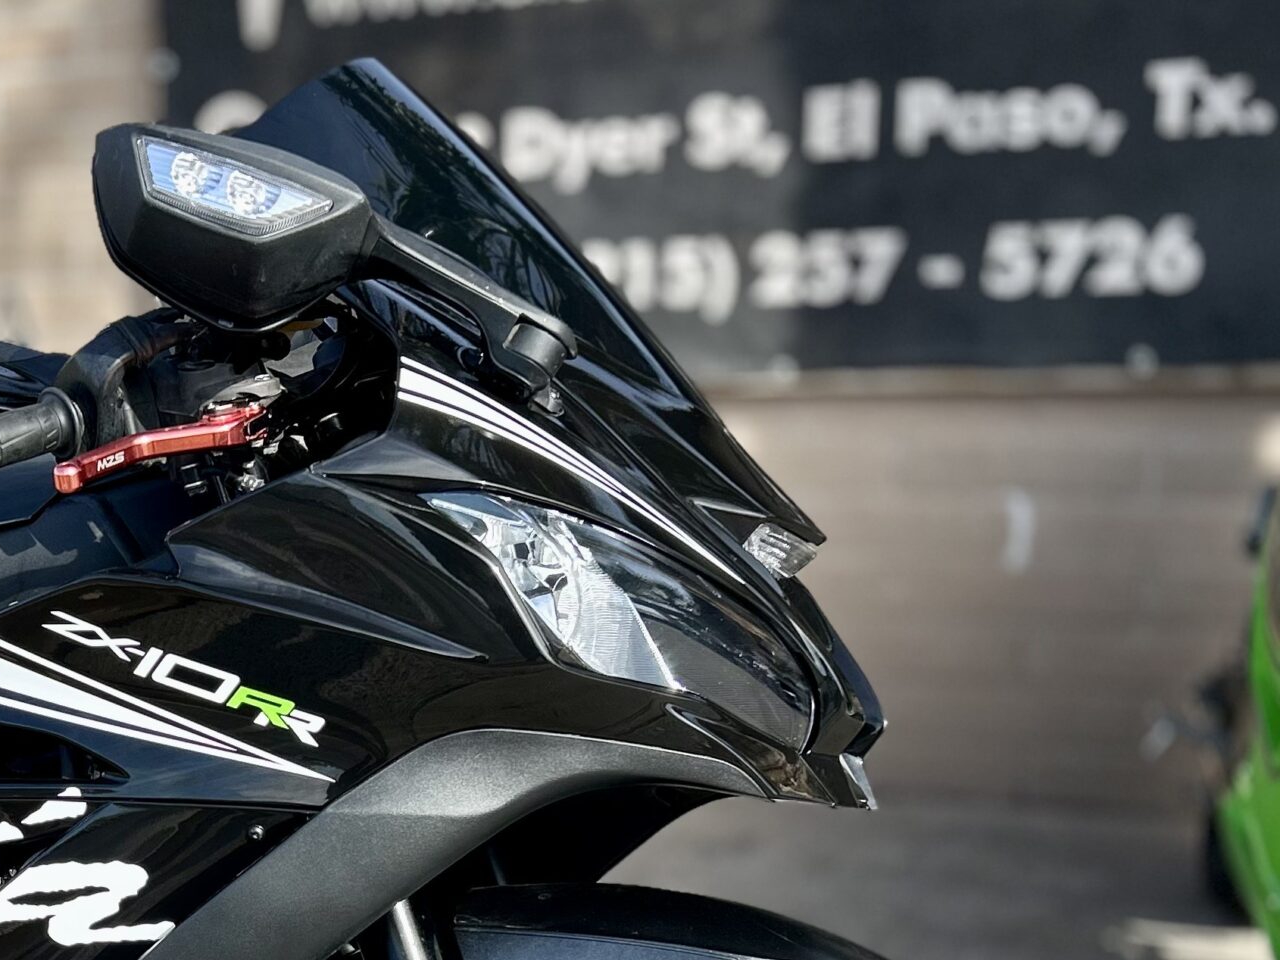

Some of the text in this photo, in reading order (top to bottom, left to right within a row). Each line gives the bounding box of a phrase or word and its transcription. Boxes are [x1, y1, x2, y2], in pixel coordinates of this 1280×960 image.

[500, 107, 680, 195] Dyer
[801, 79, 881, 162] El
[893, 76, 1127, 158] Paso,
[748, 225, 910, 310] 257
[979, 213, 1207, 301] 5726
